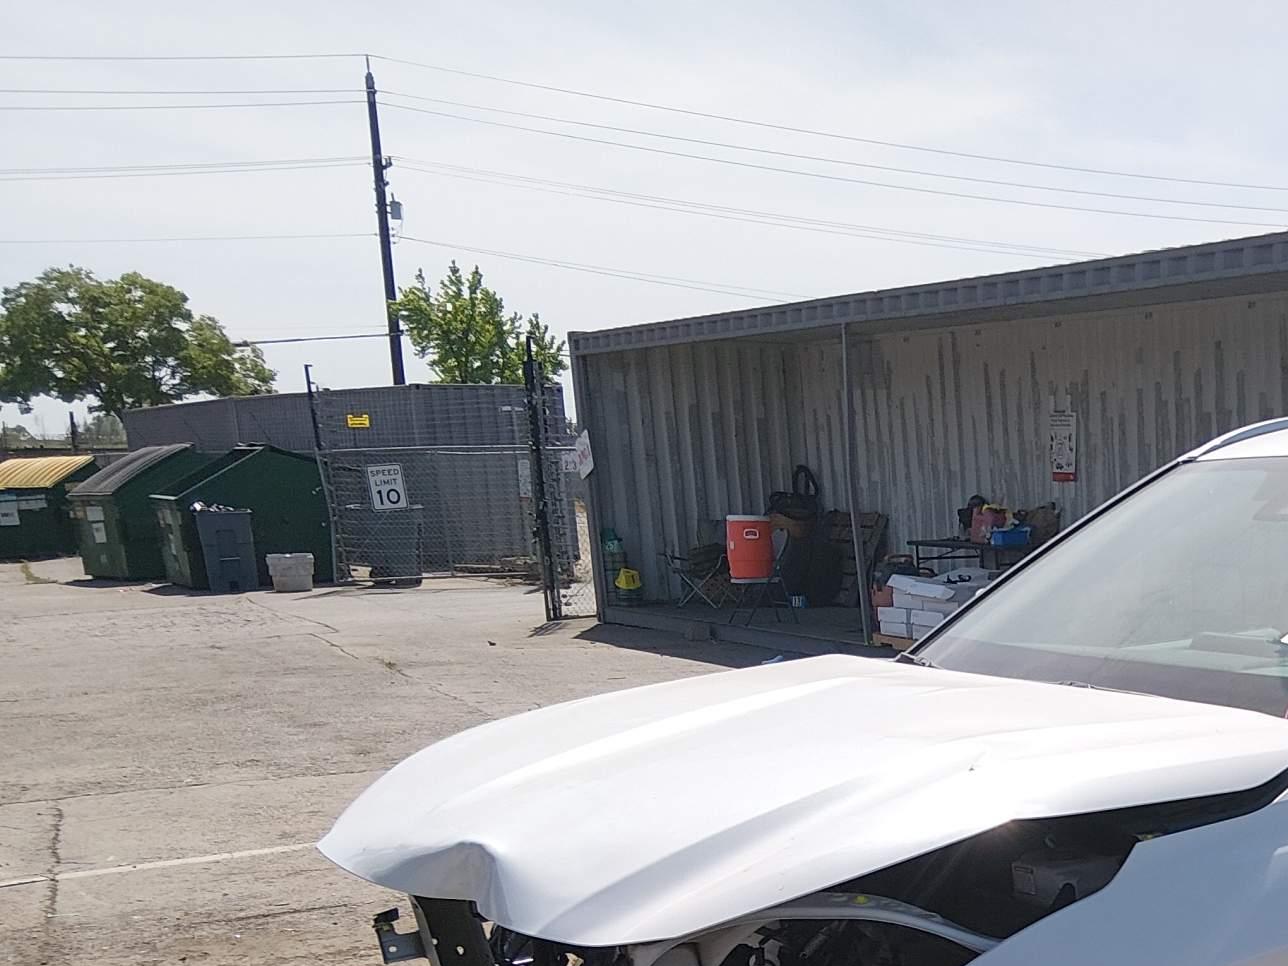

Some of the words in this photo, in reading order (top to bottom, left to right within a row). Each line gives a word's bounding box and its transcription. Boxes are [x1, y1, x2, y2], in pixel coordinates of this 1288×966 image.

[370, 469, 399, 477] SPEED
[375, 478, 397, 487] LIMIT
[376, 488, 401, 506] 10
